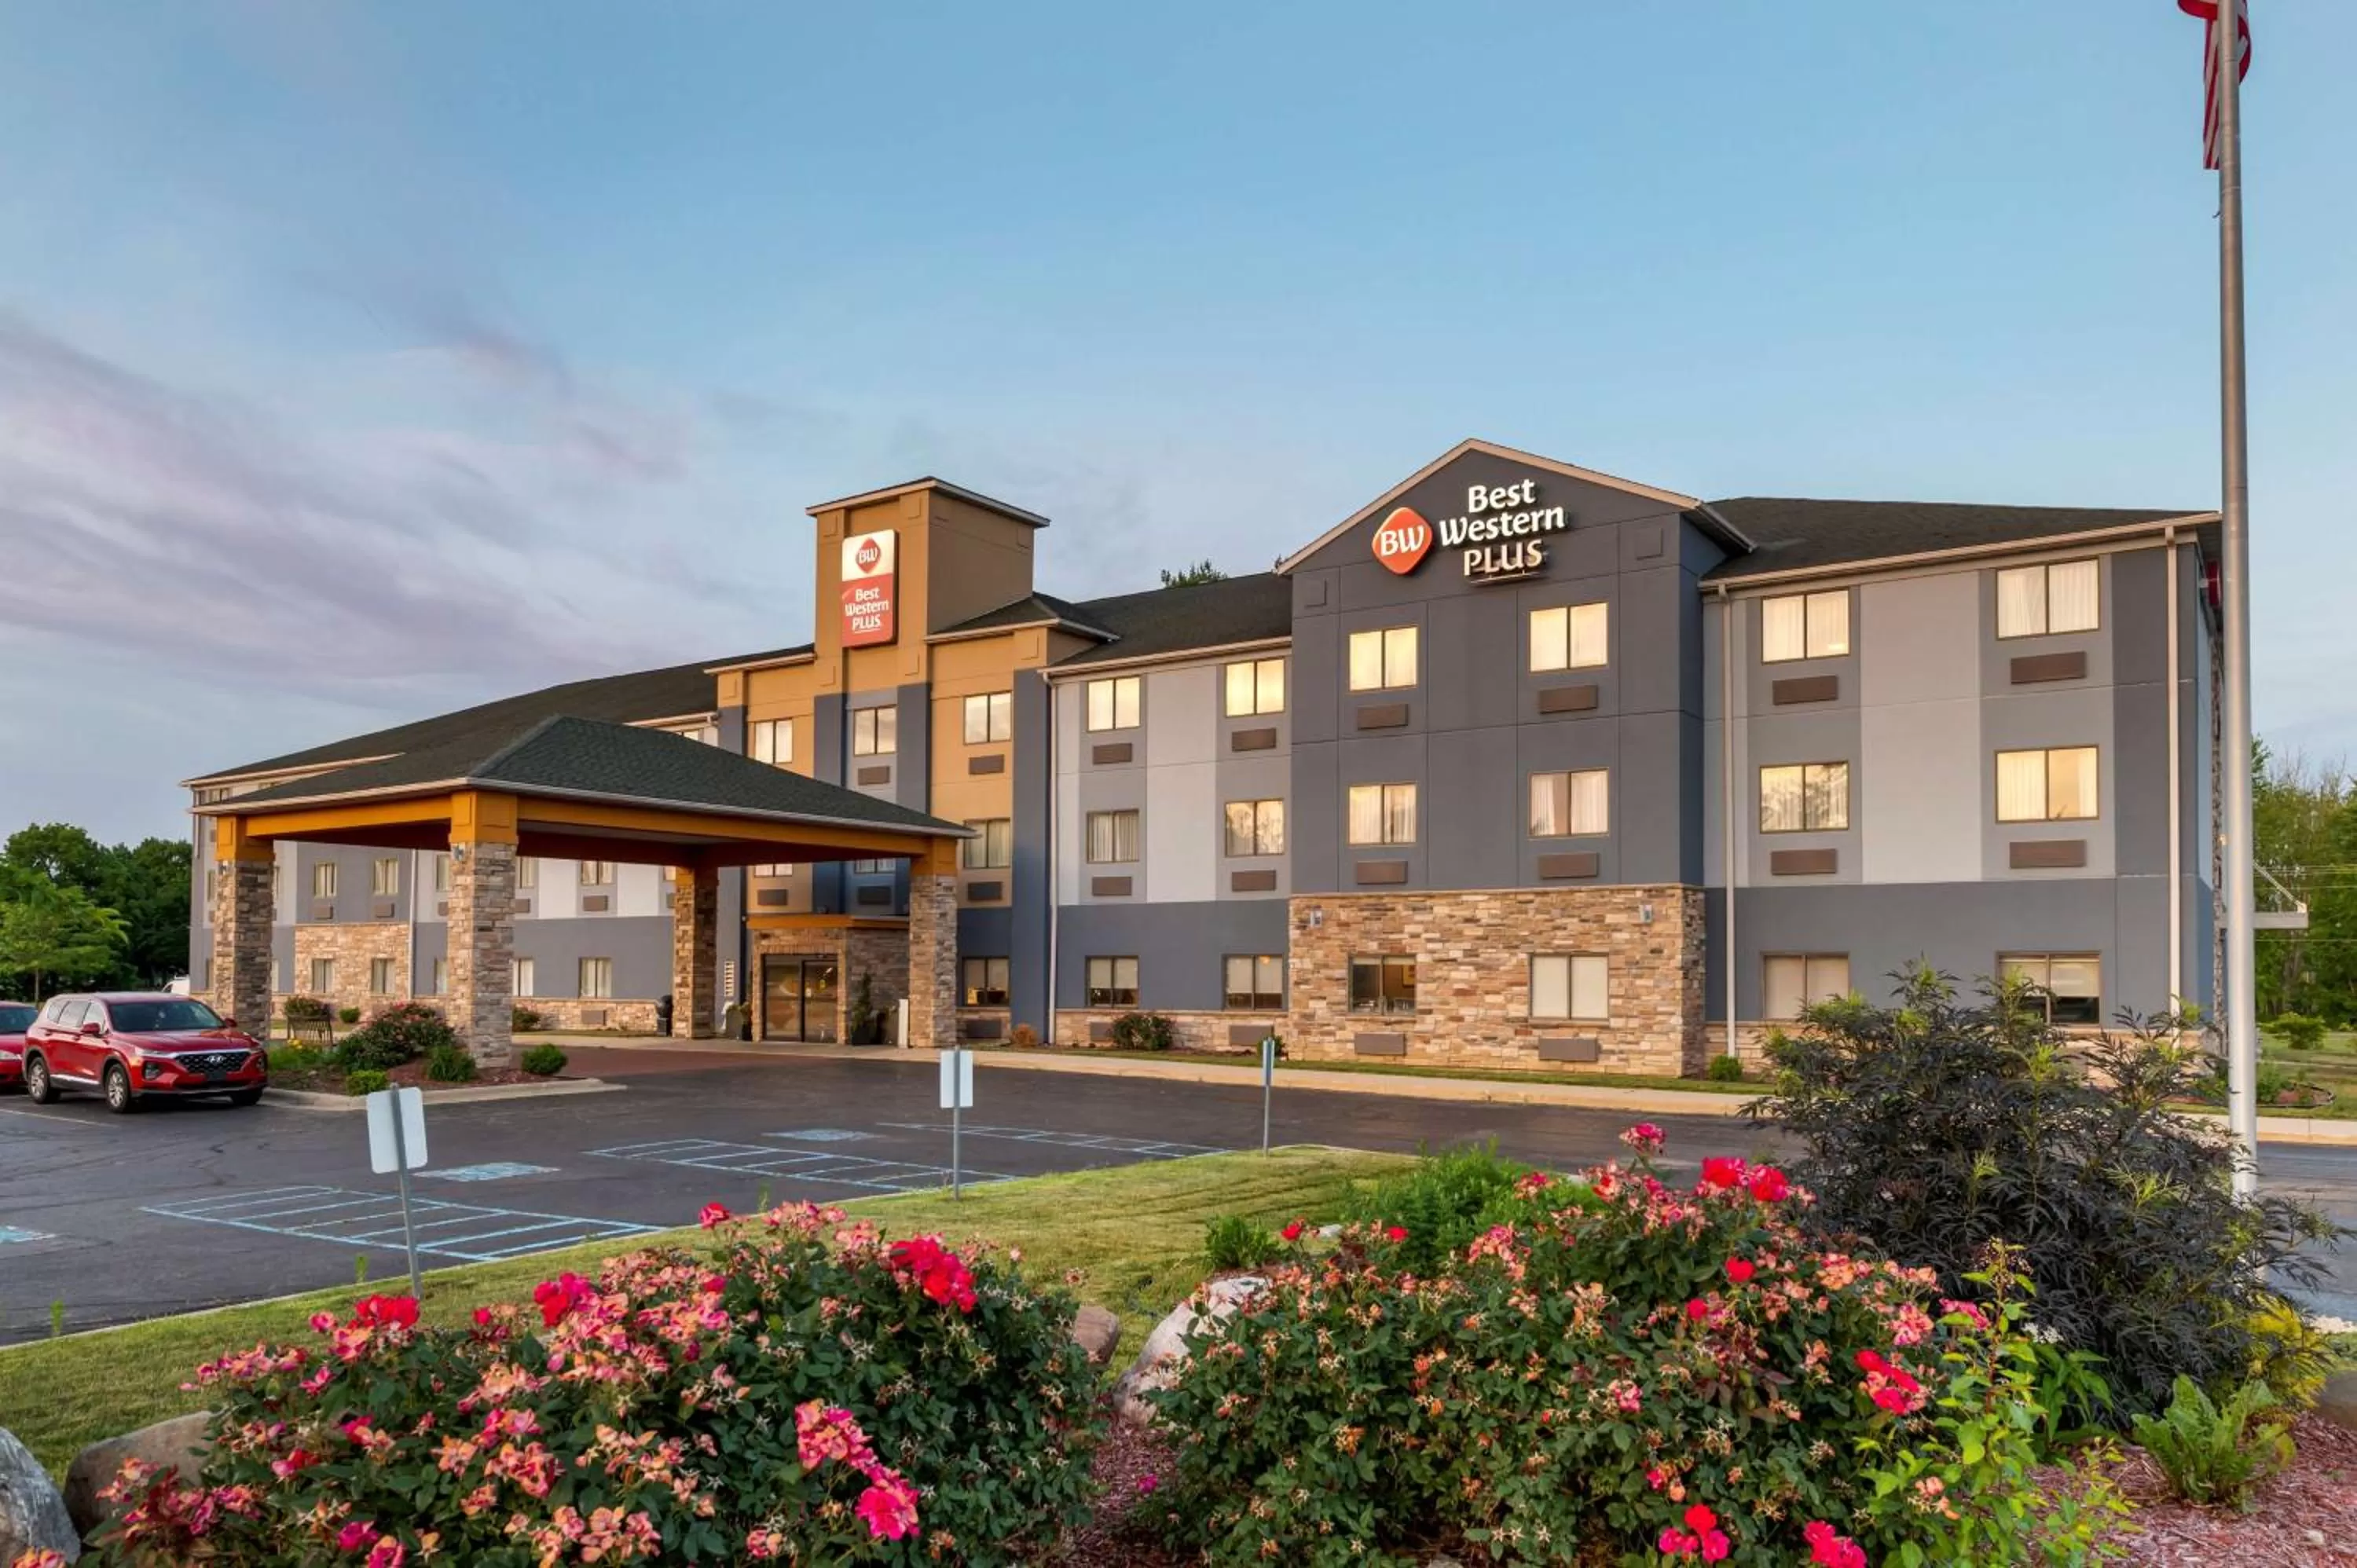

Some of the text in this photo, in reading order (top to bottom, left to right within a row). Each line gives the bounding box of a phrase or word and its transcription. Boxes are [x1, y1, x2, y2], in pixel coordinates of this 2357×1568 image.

[1468, 478, 1535, 513] Best
[1439, 506, 1565, 547] Western
[1380, 524, 1424, 556] BW
[859, 548, 878, 564] BW
[1464, 539, 1543, 576] PLUS
[855, 587, 880, 603] Best
[845, 599, 889, 617] Western
[852, 614, 881, 631] PLUS
